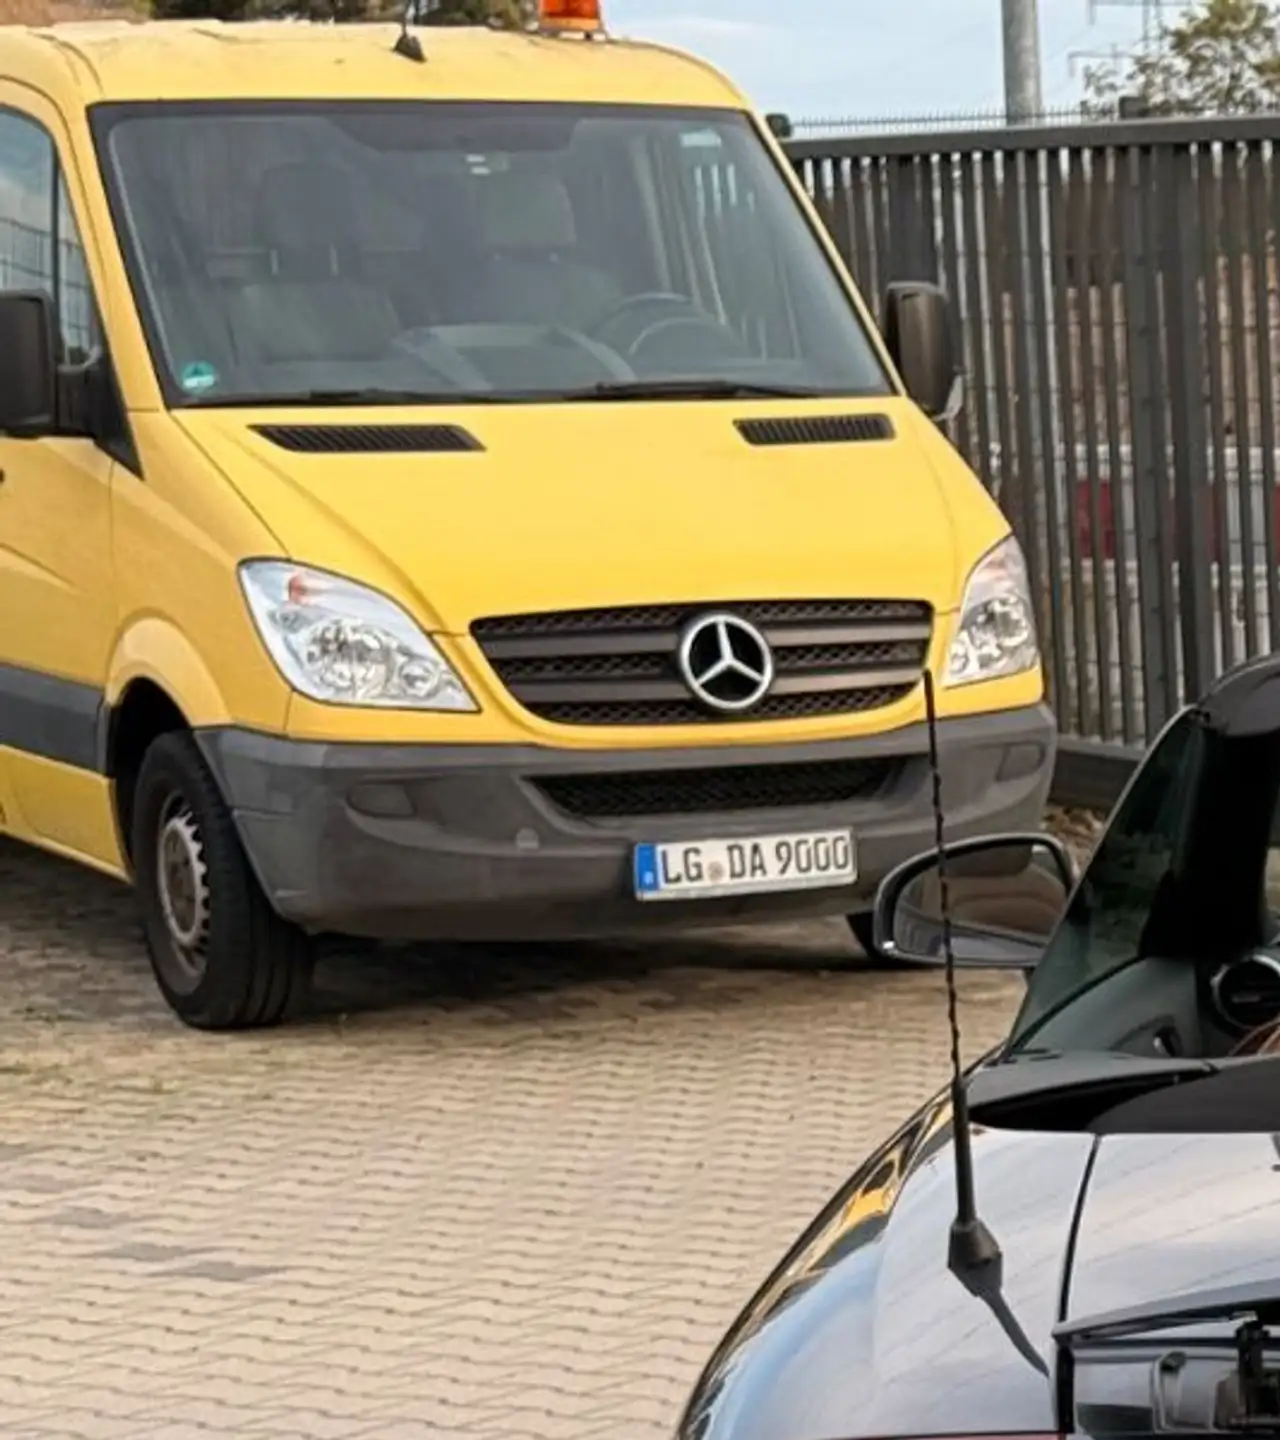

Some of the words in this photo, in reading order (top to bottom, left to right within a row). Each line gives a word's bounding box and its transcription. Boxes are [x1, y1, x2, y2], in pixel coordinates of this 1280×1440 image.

[662, 847, 704, 884] LG
[727, 843, 767, 879] DA
[775, 836, 850, 875] 9000
